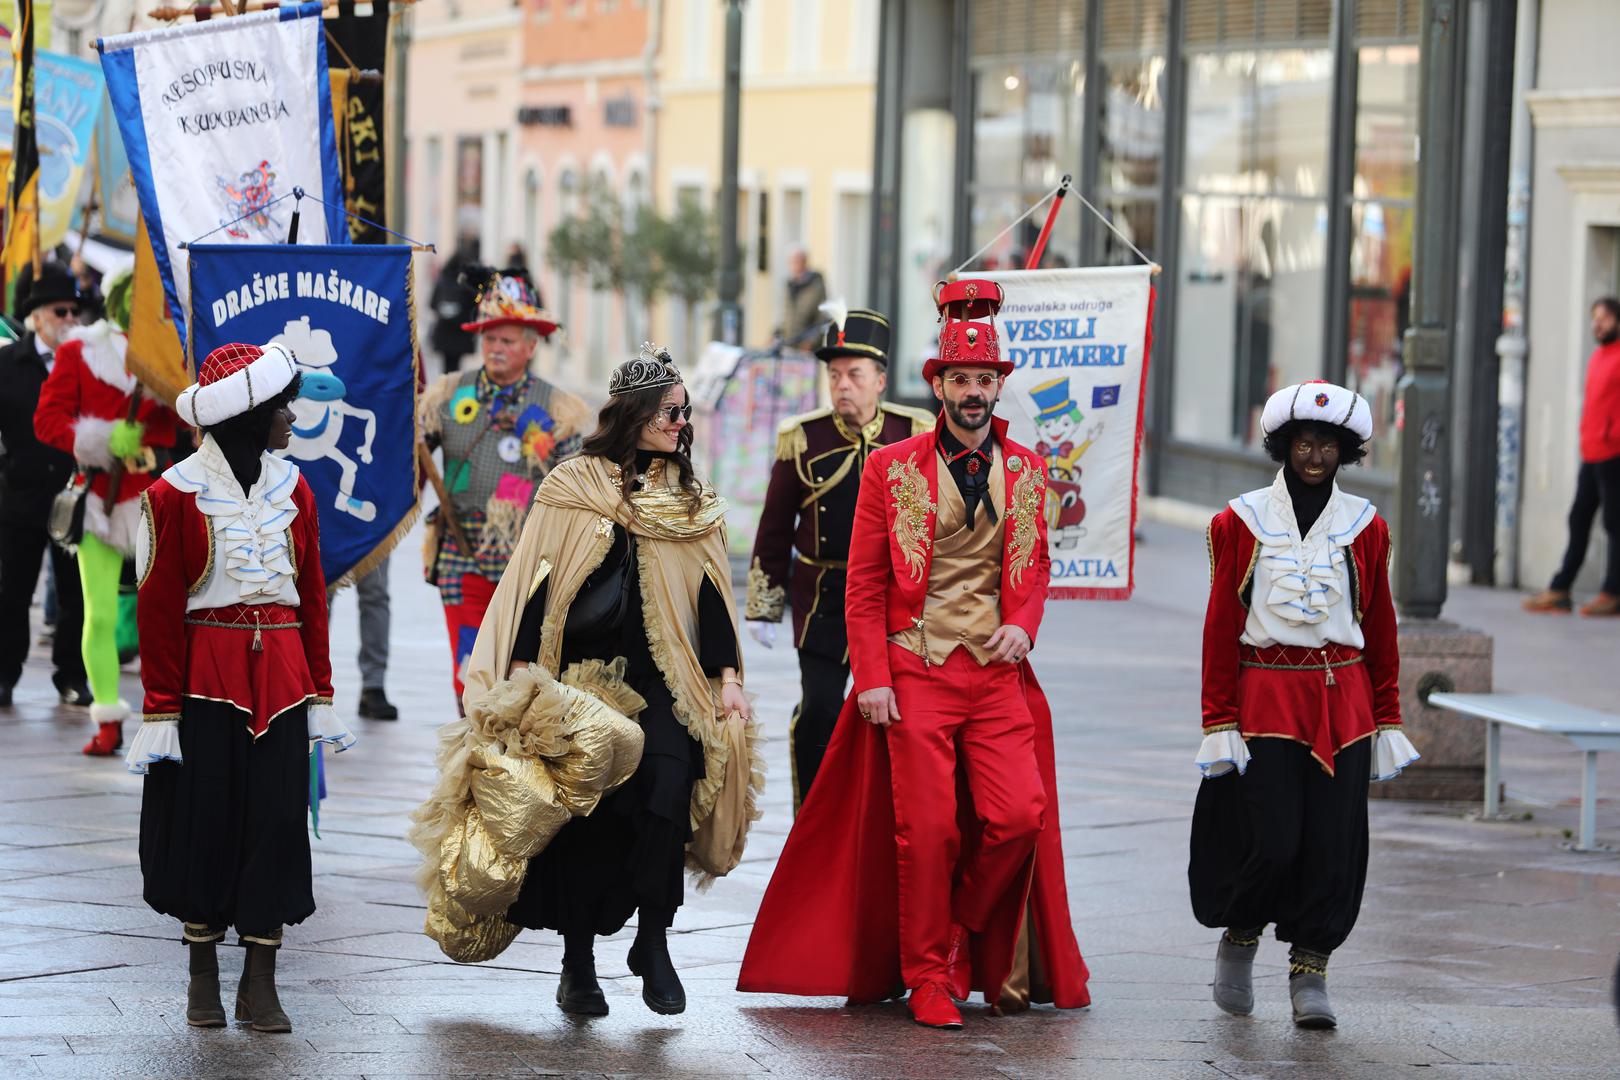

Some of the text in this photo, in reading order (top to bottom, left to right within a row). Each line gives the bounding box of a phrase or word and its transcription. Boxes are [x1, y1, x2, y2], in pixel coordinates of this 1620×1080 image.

[177, 100, 290, 136] KUMPANIJA
[212, 269, 391, 327] DRAŠKE MAŠKARE
[999, 300, 1113, 313] arnevalska udruga
[1004, 316, 1097, 341] VESELI
[1008, 344, 1127, 369] DTIMERI
[1049, 559, 1119, 578] OATIA
